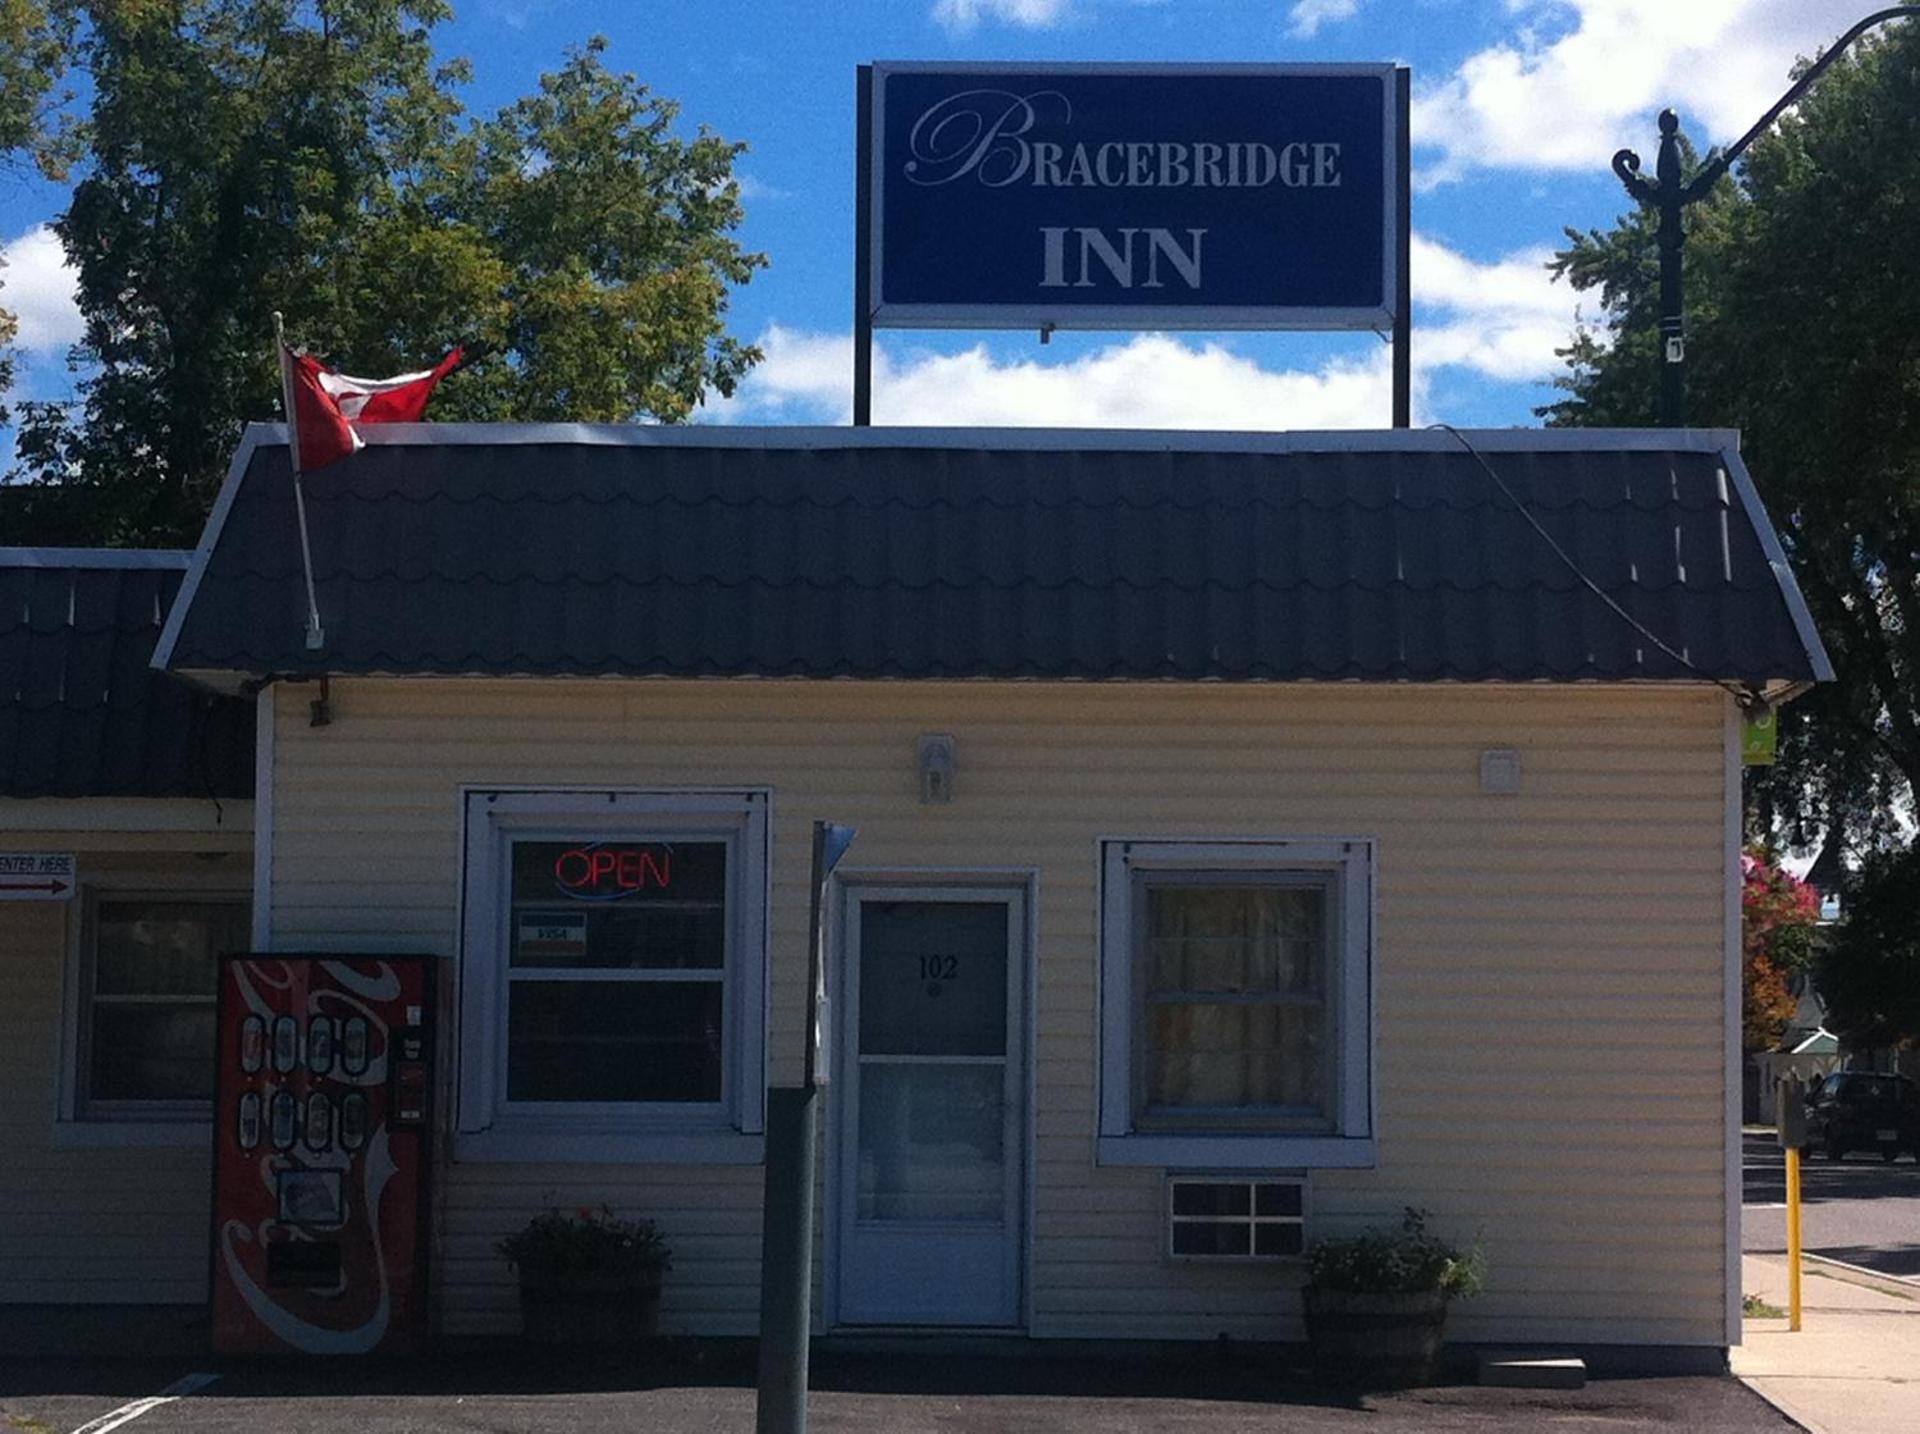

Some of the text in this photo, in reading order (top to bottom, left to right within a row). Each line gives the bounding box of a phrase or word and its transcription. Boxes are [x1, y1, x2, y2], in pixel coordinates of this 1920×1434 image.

[903, 90, 1341, 187] BRACEBRIDGE
[1038, 227, 1208, 288] INN
[40, 856, 71, 871] HERE
[555, 850, 671, 887] OPEN
[920, 954, 958, 980] 102
